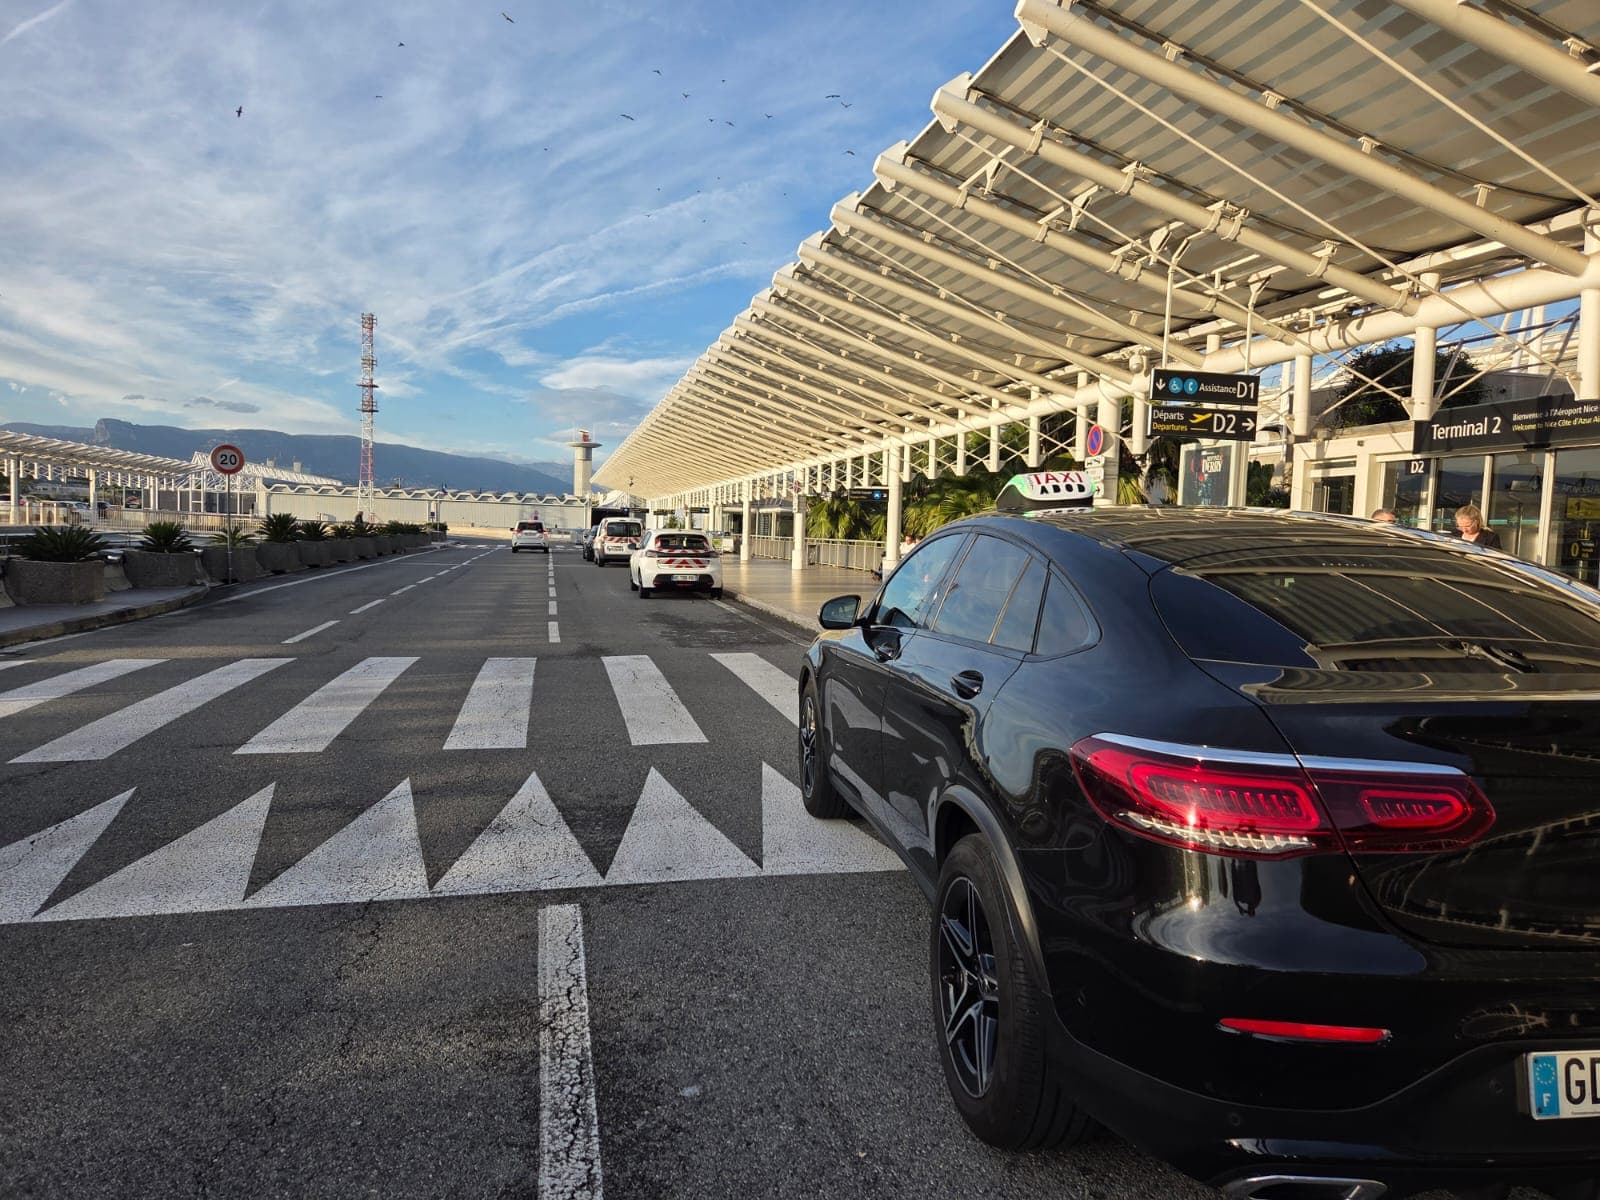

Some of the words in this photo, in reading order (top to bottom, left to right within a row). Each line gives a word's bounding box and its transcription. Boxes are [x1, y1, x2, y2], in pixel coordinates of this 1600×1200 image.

[1199, 383, 1237, 394] Assistance
[1236, 381, 1255, 399] D1
[1583, 404, 1599, 413] Nice
[1153, 409, 1184, 421] Départs
[1213, 413, 1236, 434] D2
[1153, 422, 1188, 432] Departures
[1431, 416, 1488, 440] Terminal
[1491, 416, 1501, 434] 2
[220, 454, 237, 466] 20
[1410, 460, 1424, 474] D2
[1031, 472, 1084, 485] TAXI
[1542, 1092, 1551, 1108] F
